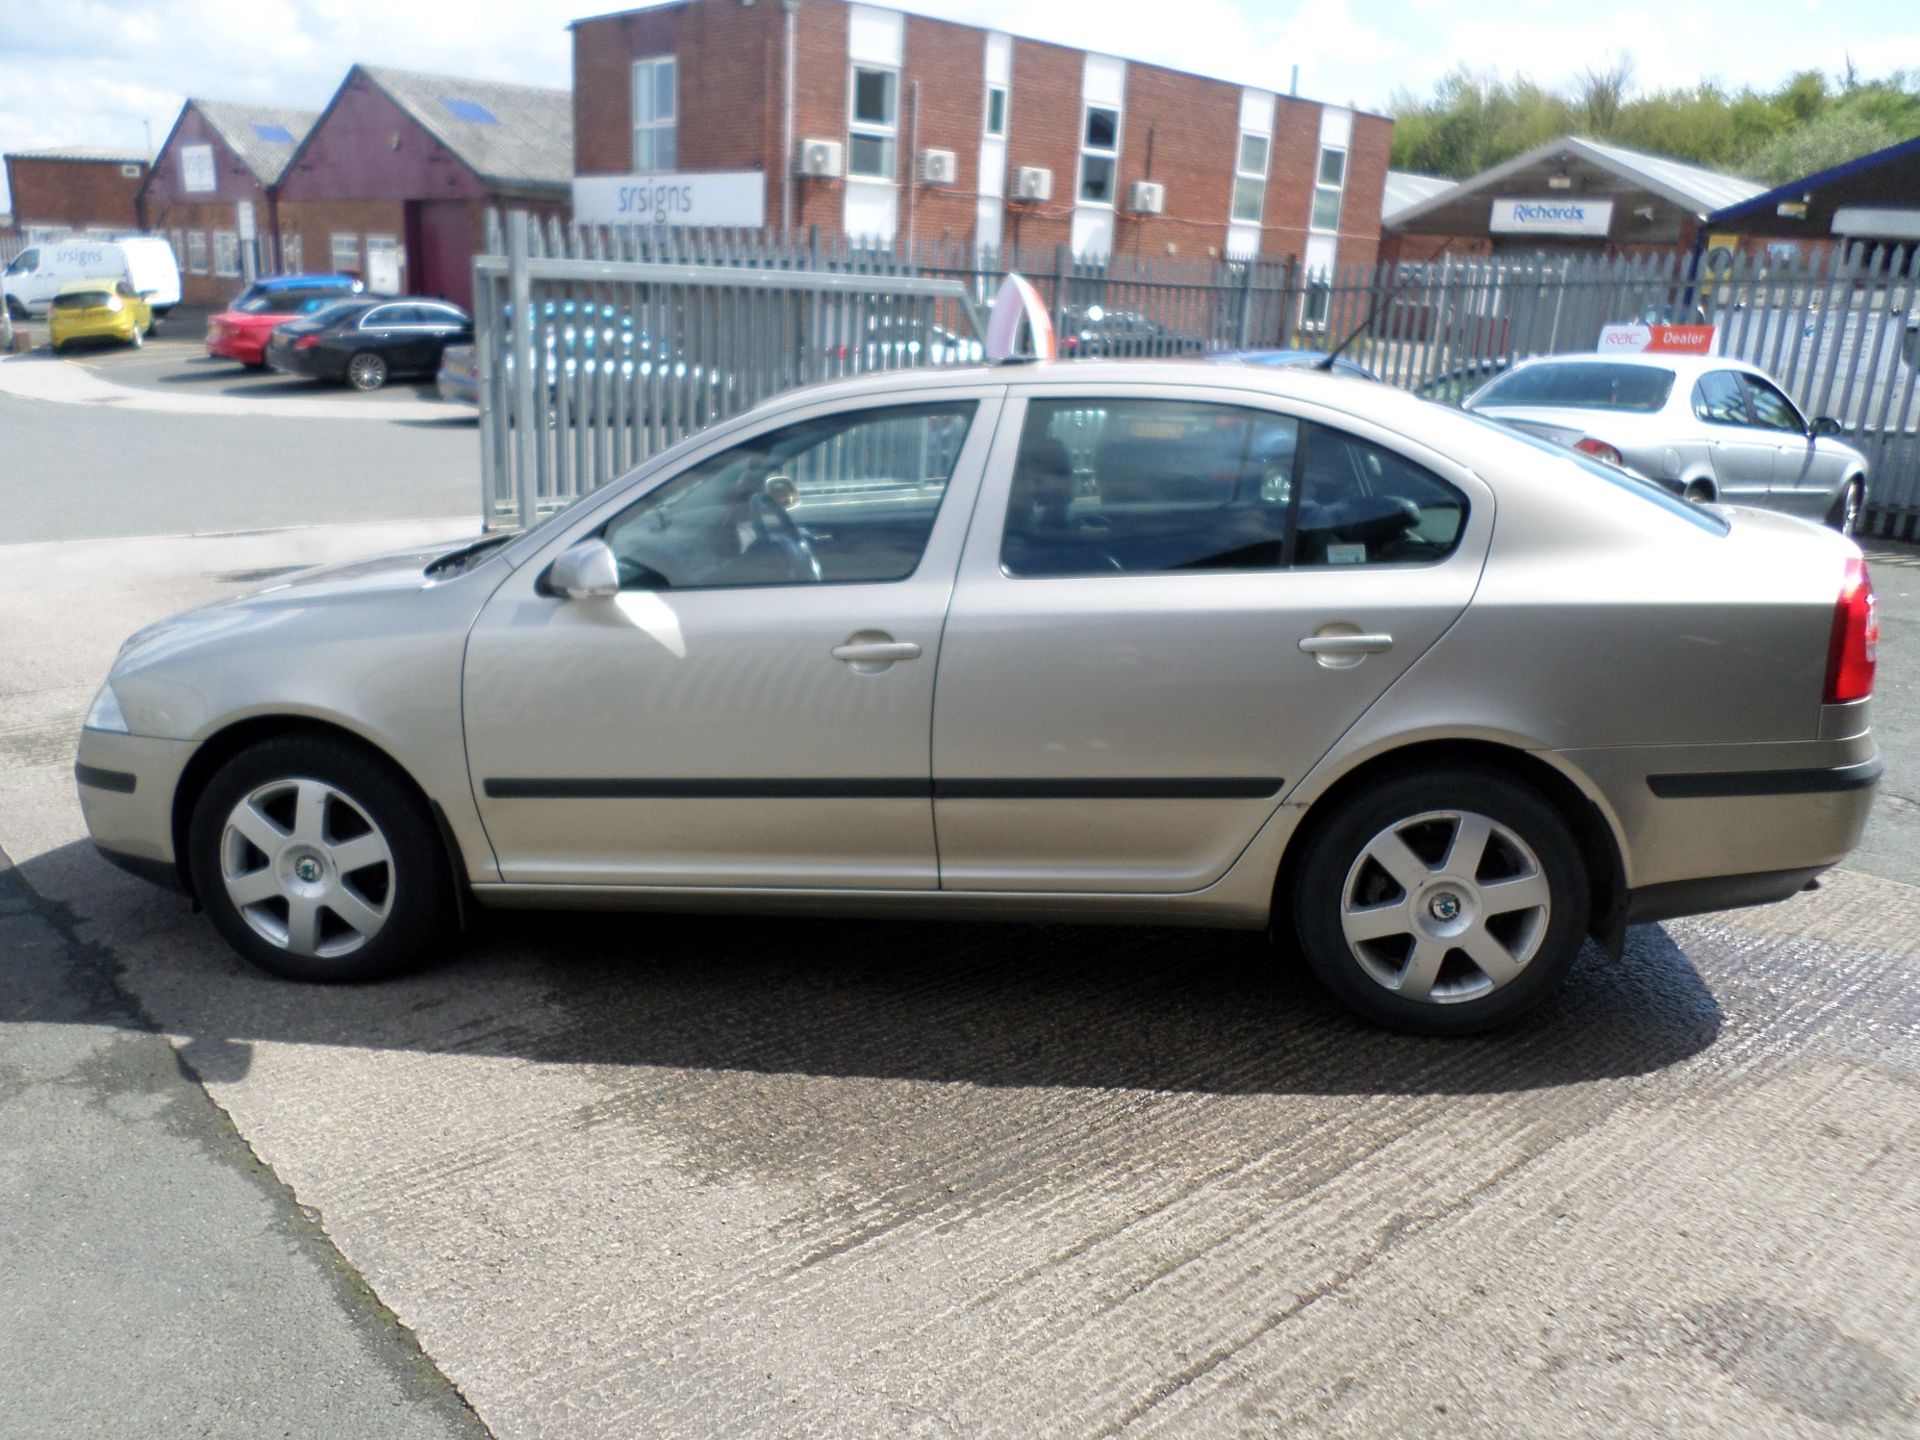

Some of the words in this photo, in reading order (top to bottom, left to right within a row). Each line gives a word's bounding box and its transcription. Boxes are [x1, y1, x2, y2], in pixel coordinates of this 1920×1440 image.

[618, 178, 692, 224] srsigns
[1513, 204, 1585, 222] Richards
[56, 249, 103, 265] srsigns
[1663, 332, 1705, 345] Dealer
